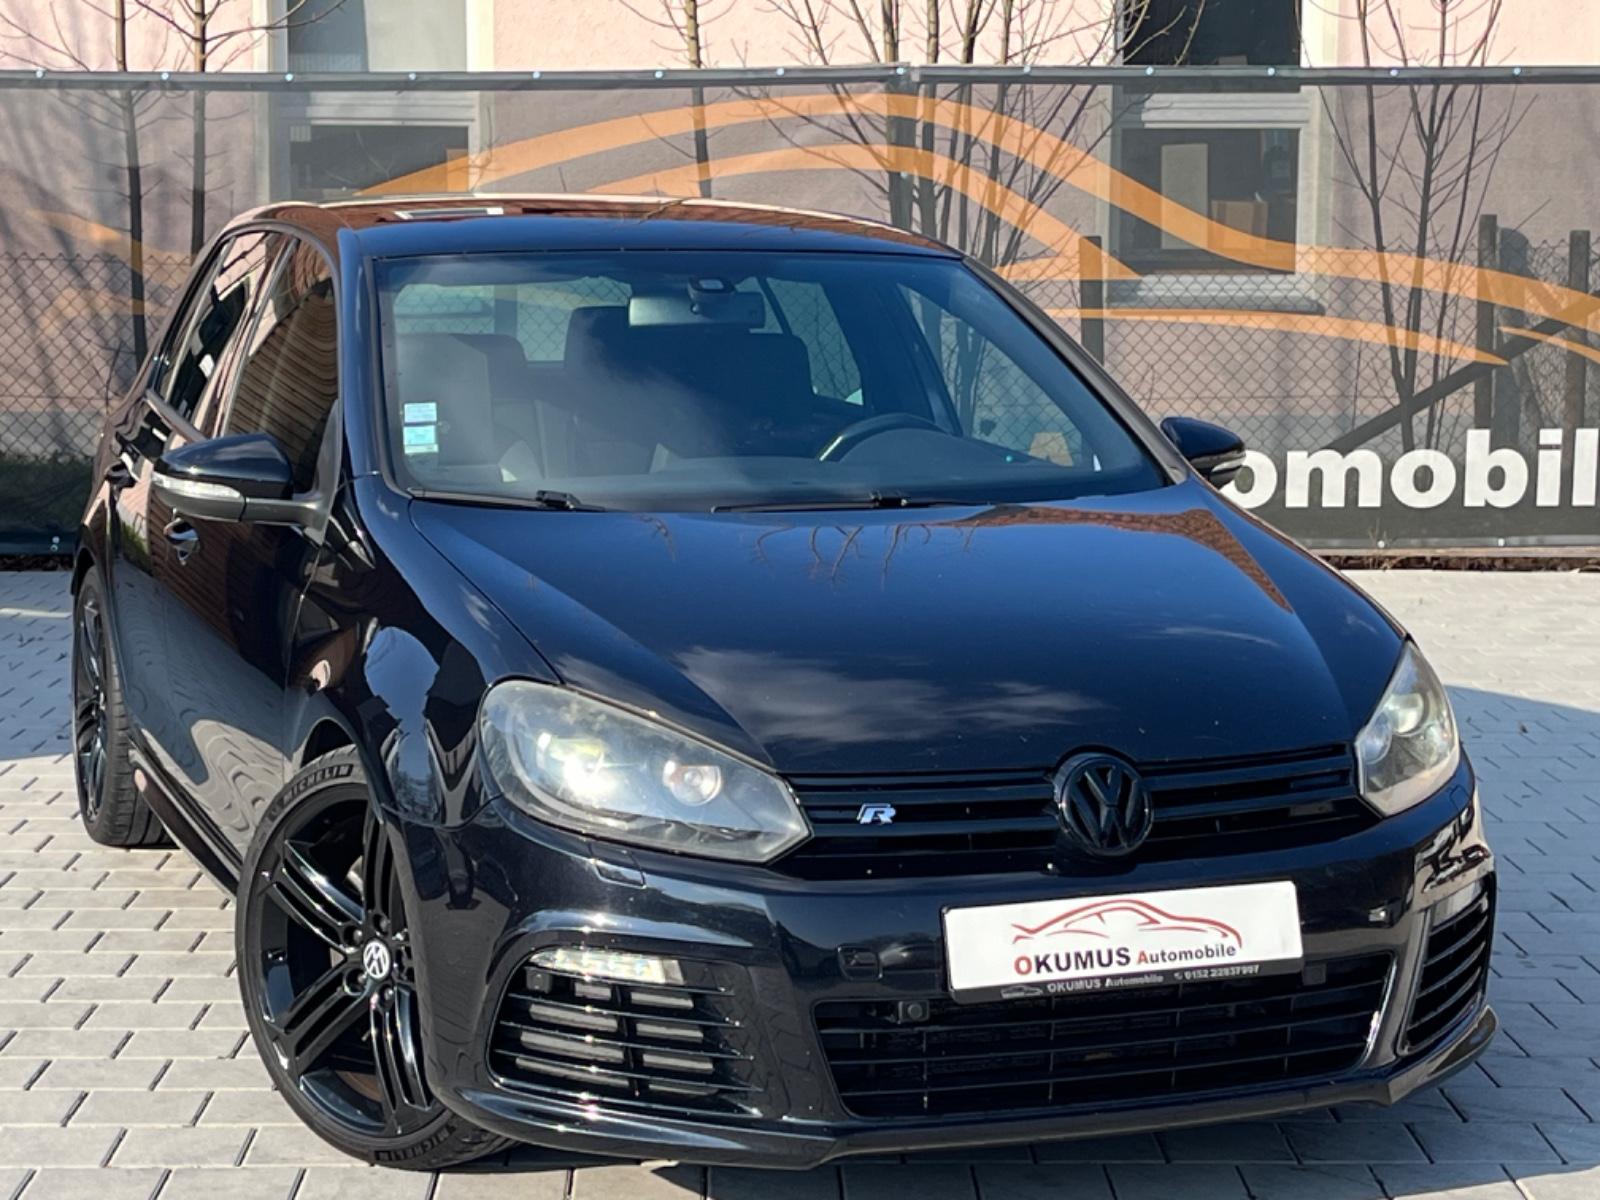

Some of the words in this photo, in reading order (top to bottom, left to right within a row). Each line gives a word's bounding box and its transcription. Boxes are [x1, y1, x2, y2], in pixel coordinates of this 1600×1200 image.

[281, 764, 351, 804] MICHELIN
[857, 803, 896, 824] R
[1014, 947, 1131, 975] OKUMUS
[1137, 944, 1236, 965] Automobile
[1047, 979, 1101, 993] OKUMUS
[1105, 973, 1163, 988] Automobile
[378, 1127, 450, 1160] MICHELIN
